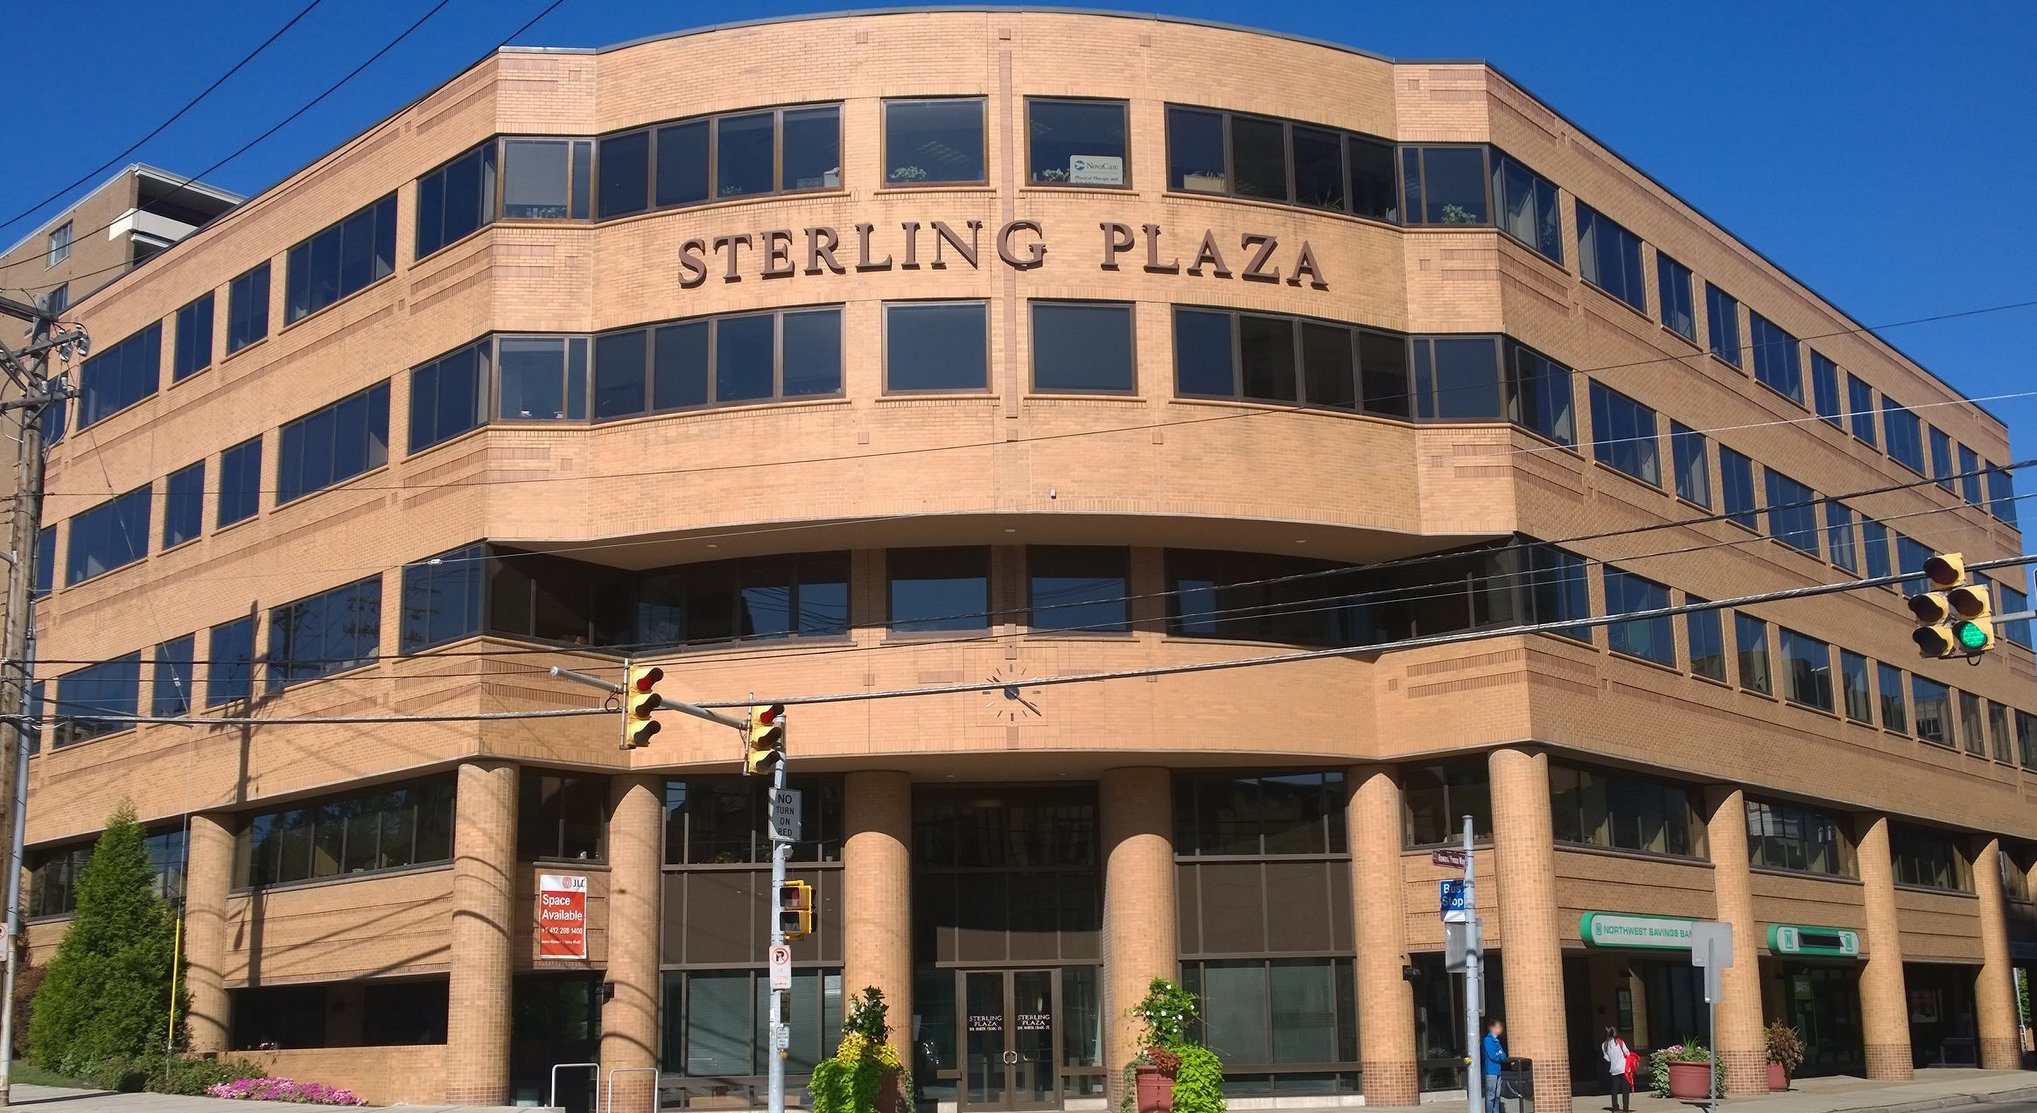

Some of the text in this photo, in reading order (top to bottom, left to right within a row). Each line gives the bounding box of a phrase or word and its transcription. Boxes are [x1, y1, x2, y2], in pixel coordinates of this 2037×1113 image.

[678, 219, 1330, 292] STERLING PLAZA
[777, 794, 793, 804] NO
[775, 806, 795, 815] TURN
[780, 817, 791, 825] ON
[777, 827, 793, 836] RED
[1443, 883, 1461, 893] Bus
[543, 894, 570, 907] Space
[1442, 897, 1464, 907] Stop
[542, 909, 582, 920] Available
[1604, 925, 1648, 936] NORTHWEST
[1649, 927, 1679, 938] SAVINGS
